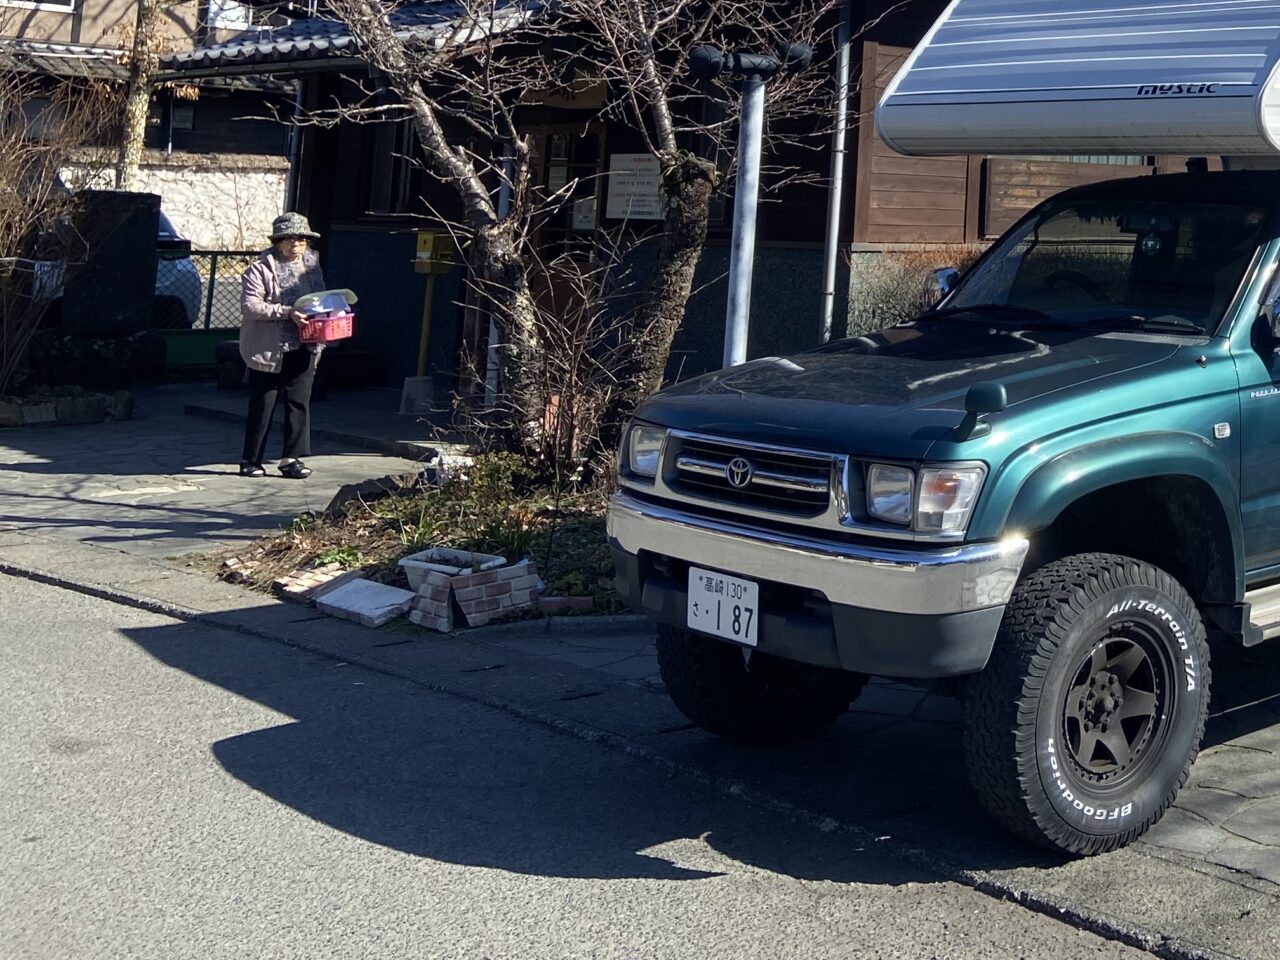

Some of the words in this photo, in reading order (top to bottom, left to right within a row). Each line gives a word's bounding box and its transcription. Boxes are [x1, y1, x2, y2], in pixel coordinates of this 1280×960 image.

[692, 601, 699, 618] さ
[1183, 654, 1196, 692] T/A
[1047, 738, 1133, 820] BFGoodrich
